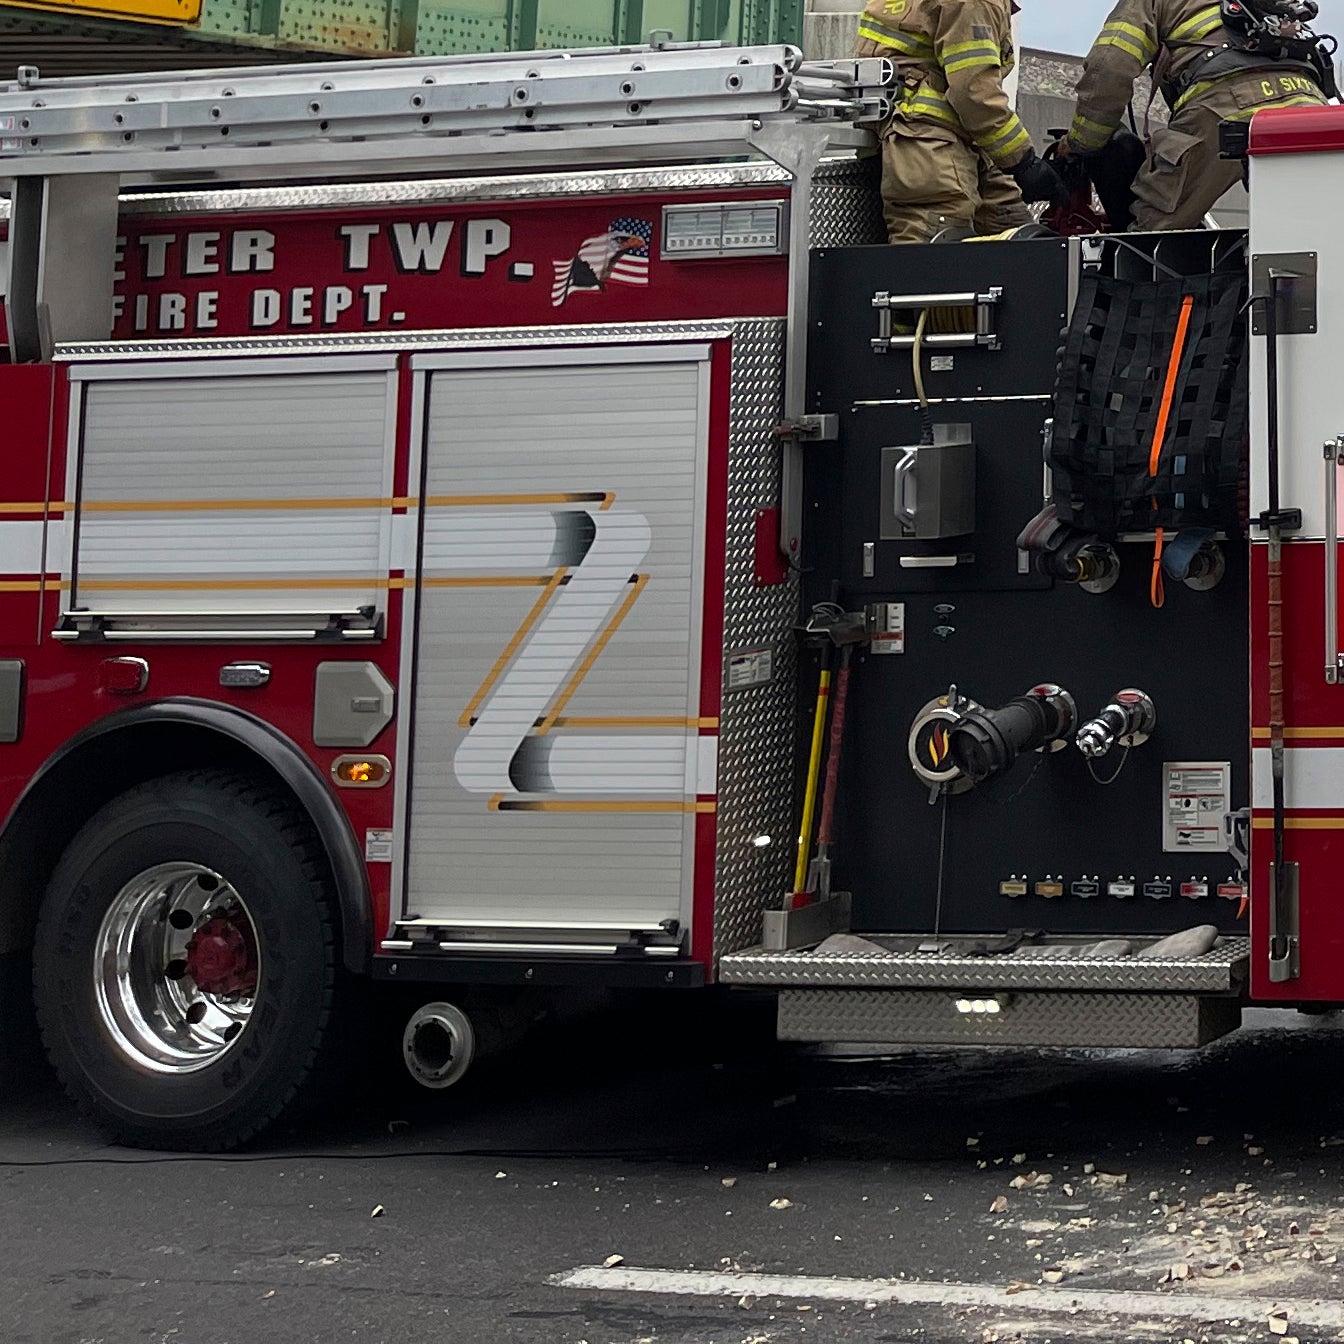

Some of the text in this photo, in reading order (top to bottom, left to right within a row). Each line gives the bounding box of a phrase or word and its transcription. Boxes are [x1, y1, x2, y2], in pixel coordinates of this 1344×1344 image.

[340, 218, 535, 277] TWP.
[111, 284, 406, 331] FIRE DEPT.
